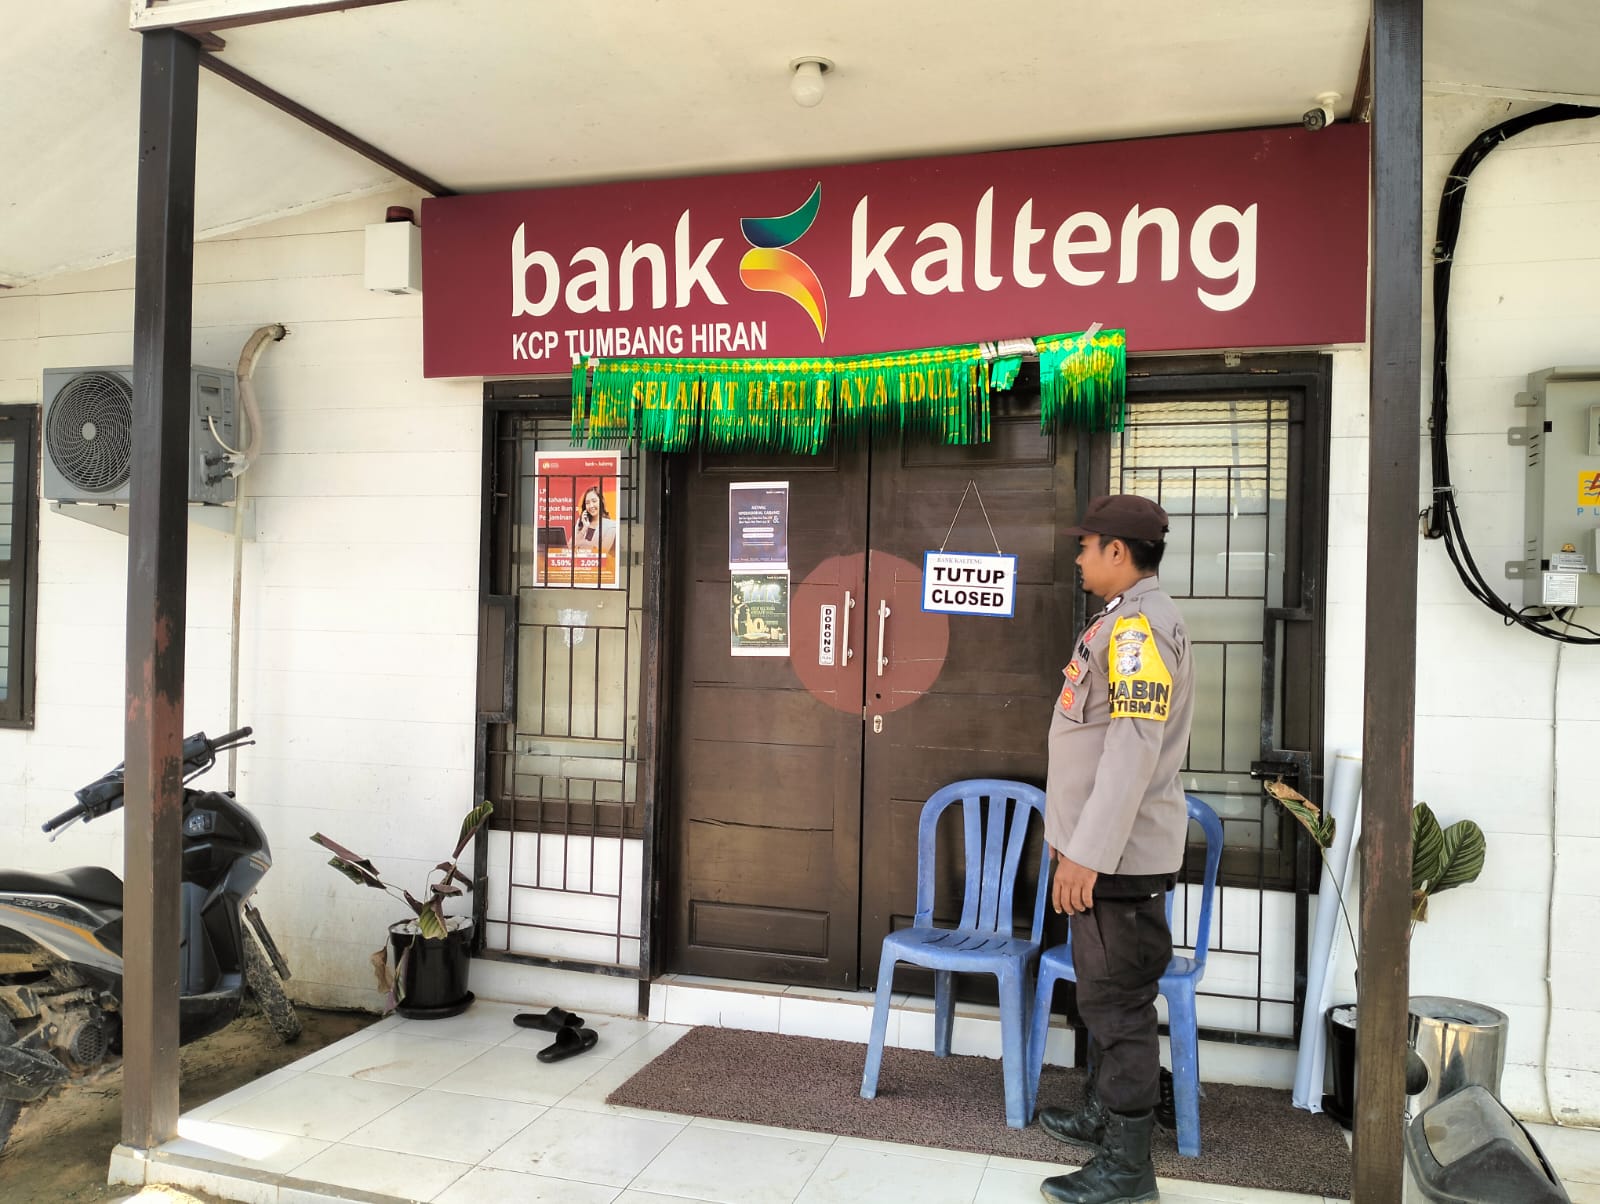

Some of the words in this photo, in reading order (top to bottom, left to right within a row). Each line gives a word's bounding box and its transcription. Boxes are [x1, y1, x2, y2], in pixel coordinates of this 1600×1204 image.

[511, 208, 729, 317] bank
[849, 186, 1258, 311] kalteng
[512, 331, 559, 359] KCP
[565, 324, 683, 358] TUMBANG
[691, 321, 767, 352] HIRAN
[631, 380, 738, 411] SELAMAT
[747, 380, 807, 410] HARI
[814, 375, 888, 410] RAYA
[899, 368, 959, 403] IDUL
[933, 567, 1005, 584] TUTUP
[932, 589, 1004, 607] CLOSED
[823, 608, 832, 653] DORONG
